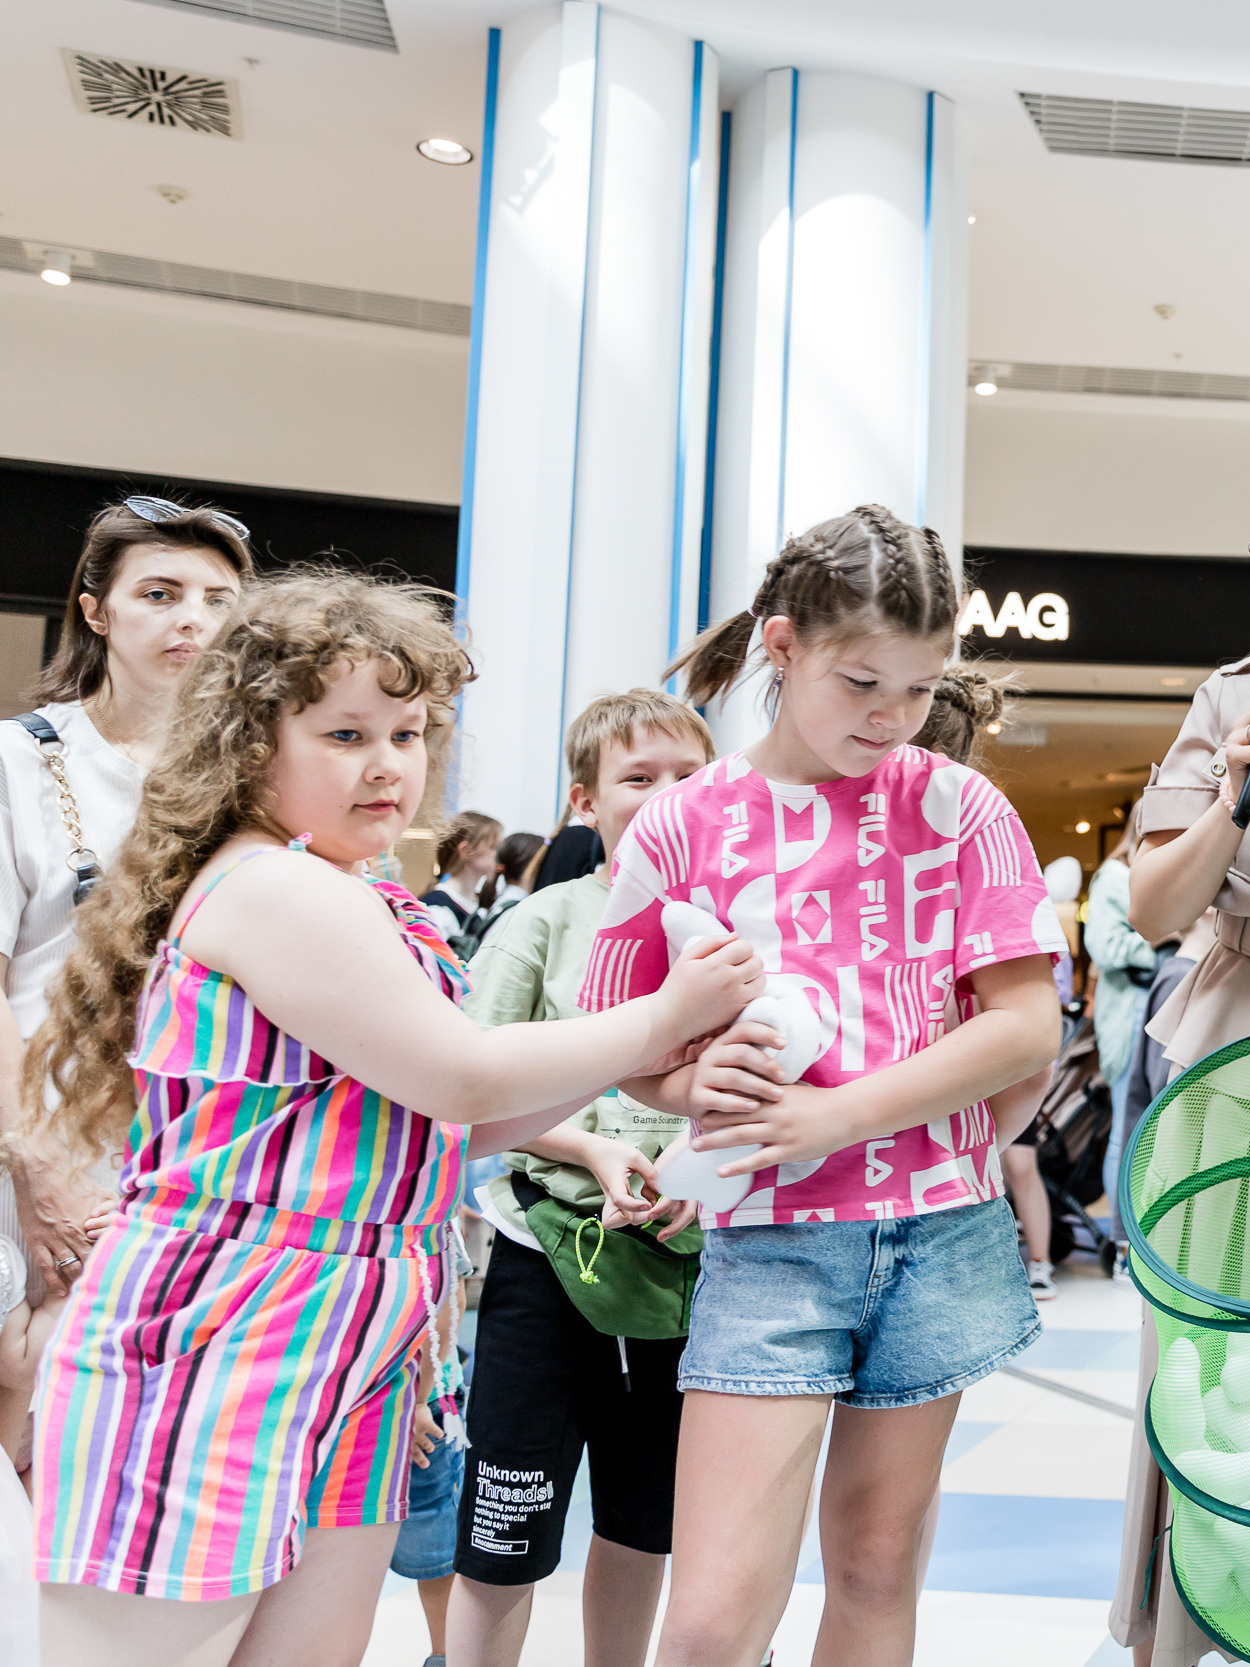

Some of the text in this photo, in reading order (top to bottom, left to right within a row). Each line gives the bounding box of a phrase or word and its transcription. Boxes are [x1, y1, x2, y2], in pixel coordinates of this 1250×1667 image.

[857, 792, 887, 868] FILA
[721, 800, 750, 880] FILA
[858, 879, 889, 962] FILA
[633, 1115, 658, 1124] Game
[478, 1460, 544, 1482] Unknown
[474, 1506, 527, 1522] nothing to special
[504, 1504, 518, 1513] you
[518, 1504, 539, 1513] don't
[473, 1514, 510, 1531] but you say it
[472, 1524, 496, 1539] sincerely
